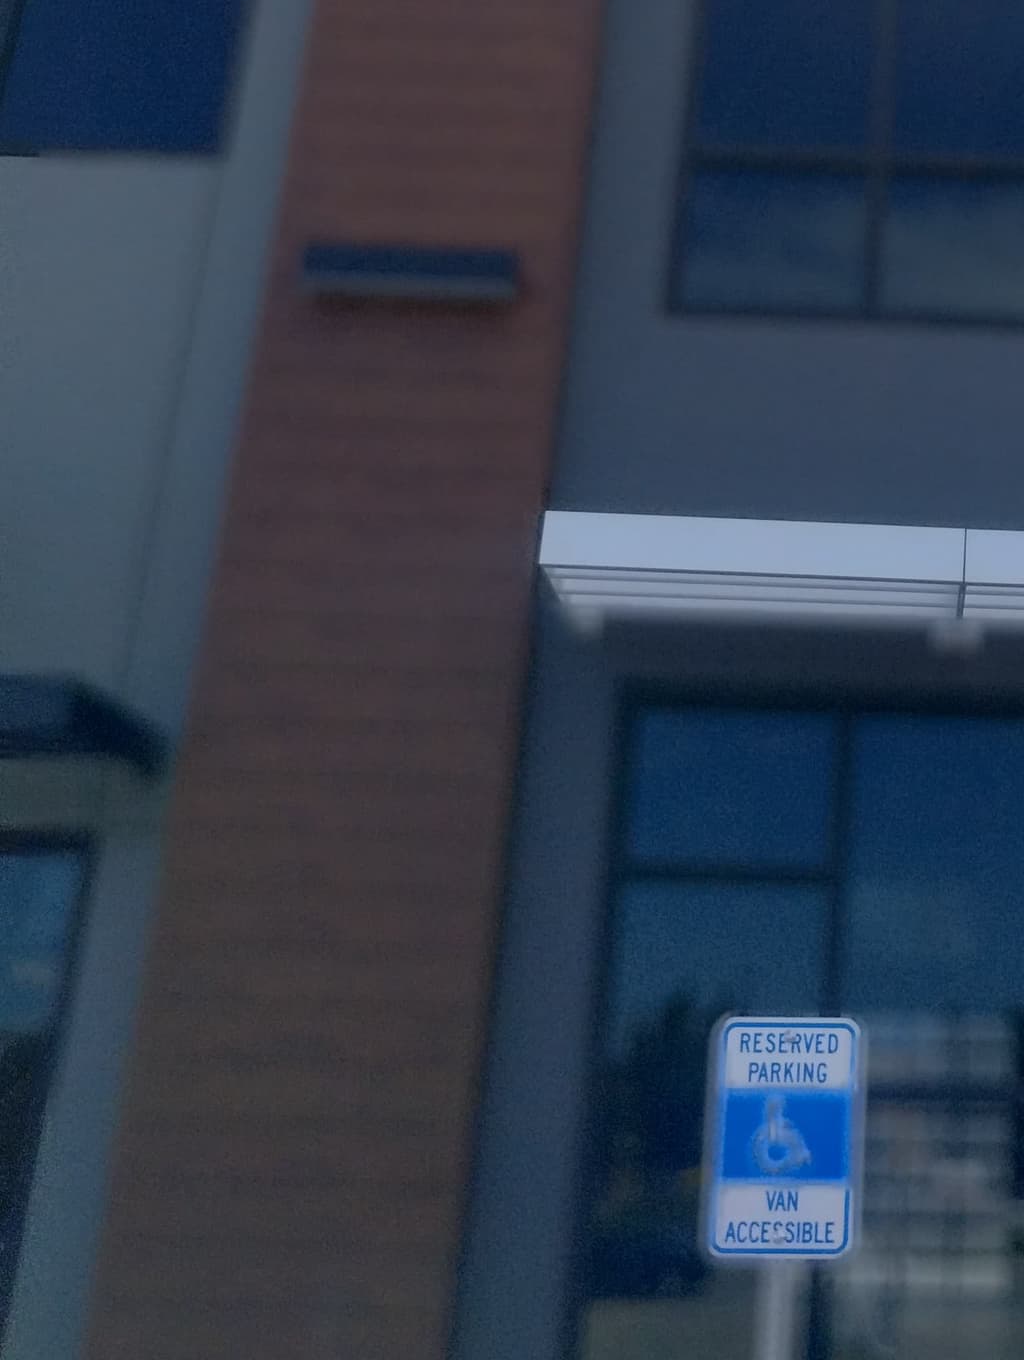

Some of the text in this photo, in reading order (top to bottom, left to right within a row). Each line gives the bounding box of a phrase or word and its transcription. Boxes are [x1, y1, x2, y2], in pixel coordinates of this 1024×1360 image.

[739, 1033, 839, 1054] RESERVED
[748, 1062, 828, 1084] PARKING
[766, 1190, 799, 1212] VAN
